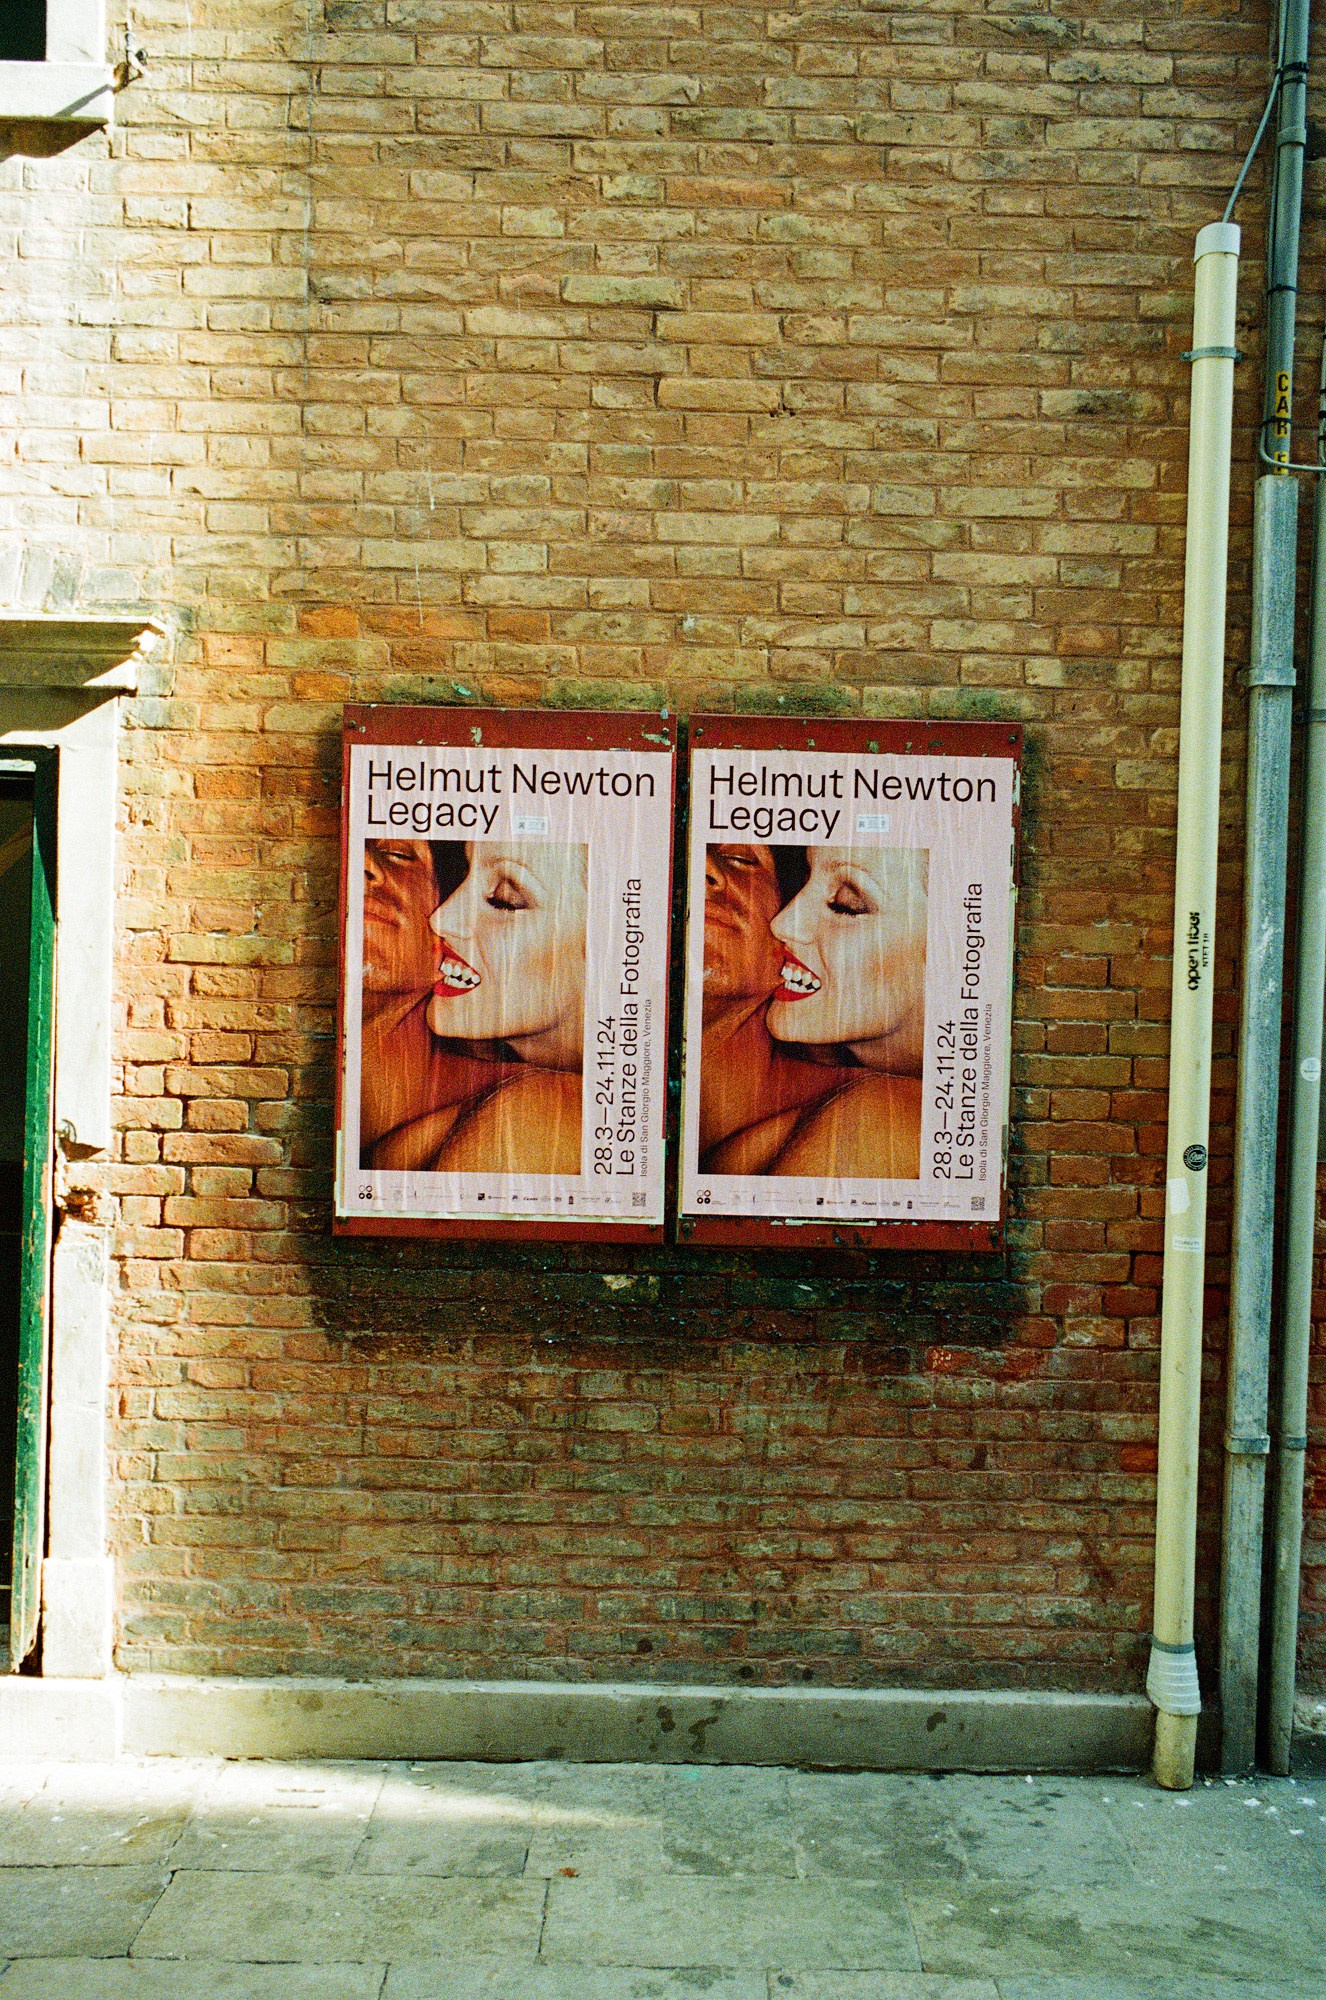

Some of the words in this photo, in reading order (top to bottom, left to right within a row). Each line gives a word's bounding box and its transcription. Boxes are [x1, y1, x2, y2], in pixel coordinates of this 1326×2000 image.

[368, 760, 502, 794] Helmut
[512, 763, 655, 797] Newton
[710, 764, 844, 799] Helmut
[854, 768, 996, 803] Newton
[367, 794, 500, 835] Legacy
[709, 799, 841, 840] Legacy
[620, 879, 644, 995] Fotografia
[960, 883, 986, 1000] Fotografia
[1187, 948, 1202, 991] open
[619, 1003, 638, 1057] della
[643, 999, 651, 1036] Venezia
[959, 1008, 979, 1061] della
[983, 1004, 992, 1041] Venezia
[642, 1040, 652, 1086] Maggiore,
[981, 1044, 992, 1090] Maggiore,
[593, 1016, 616, 1175] 28.3—24.11.24
[616, 1063, 637, 1143] Stanze
[641, 1088, 651, 1122] Giorgio
[932, 1020, 956, 1179] 28.3—24.11.24
[955, 1068, 977, 1147] Stanze
[980, 1093, 991, 1127] Giorgio
[640, 1145, 648, 1153] di
[979, 1149, 987, 1157] di
[980, 1130, 988, 1146] San
[616, 1150, 635, 1175] Le
[954, 1154, 974, 1180] Le
[979, 1160, 987, 1181] Isola
